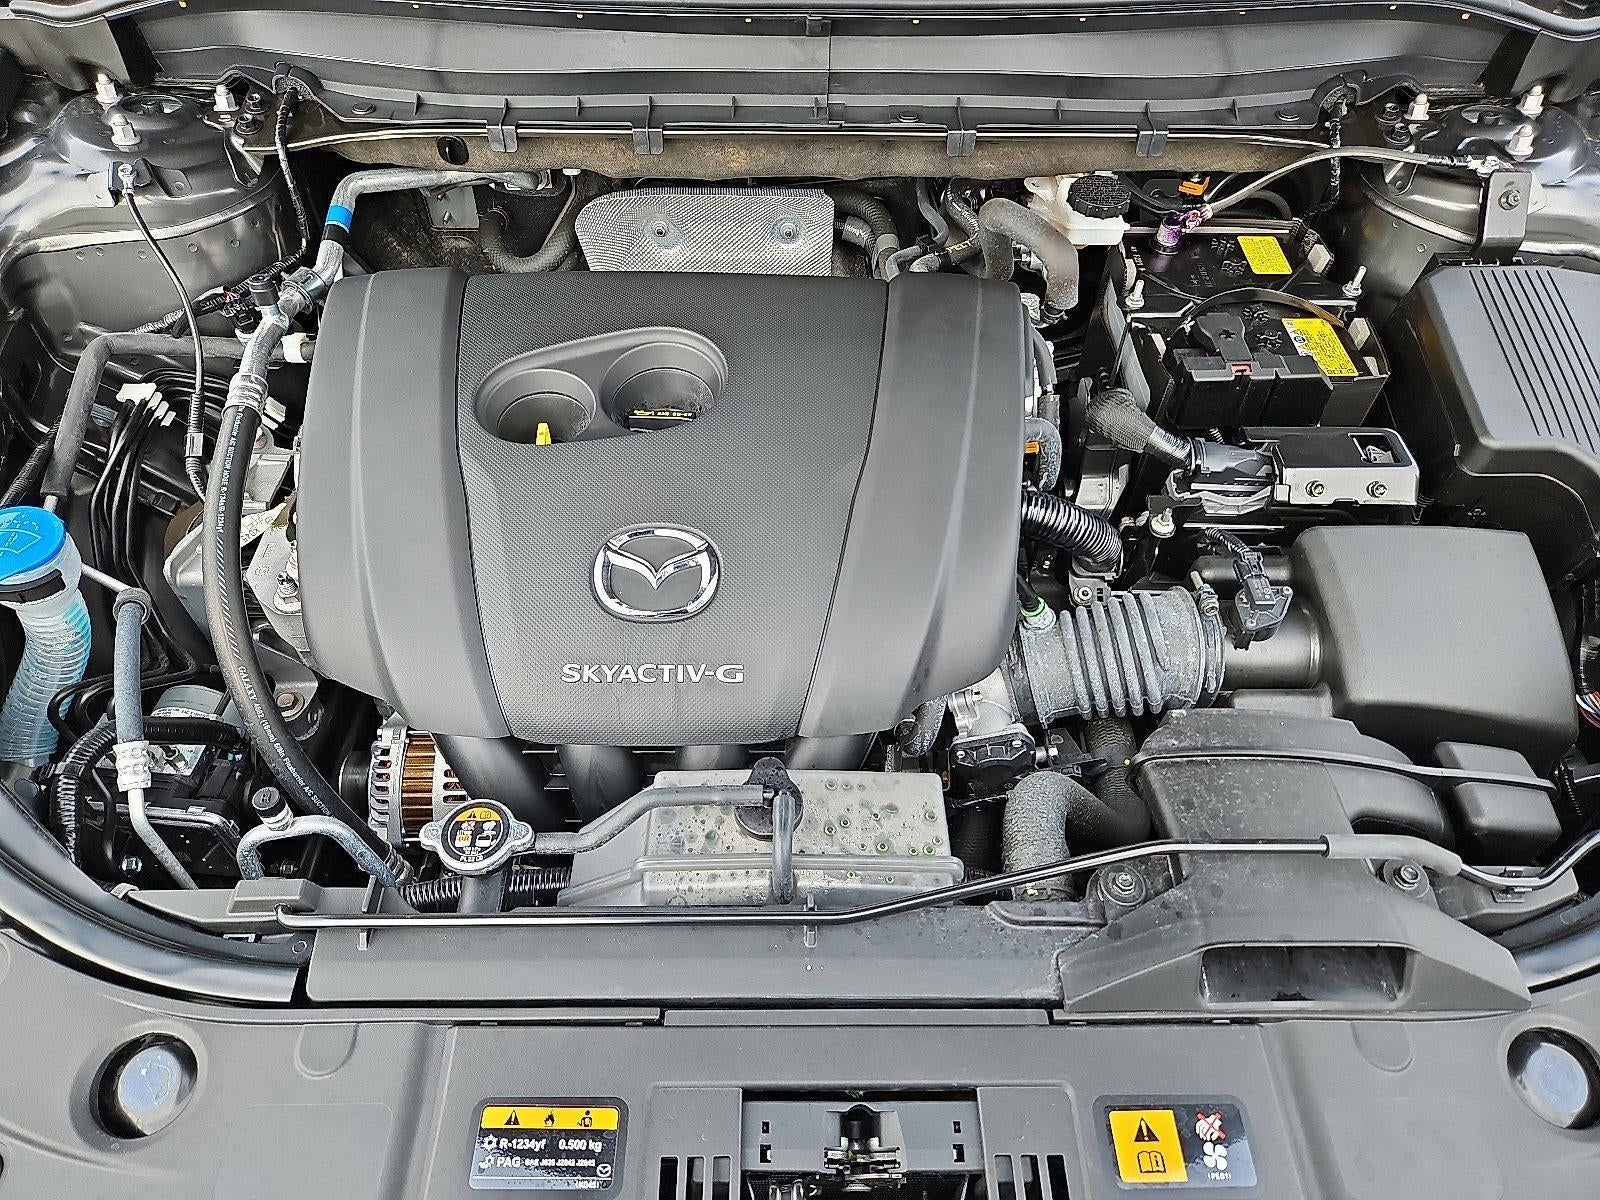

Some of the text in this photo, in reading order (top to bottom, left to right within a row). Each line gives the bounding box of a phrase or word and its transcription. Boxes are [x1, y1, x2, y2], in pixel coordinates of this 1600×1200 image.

[224, 446, 235, 470] SUCTION
[221, 470, 230, 486] HOSE
[561, 663, 745, 683] SKYACTIV-G
[238, 665, 257, 701] GALAXY
[303, 785, 315, 797] A/C
[310, 795, 332, 815] SUCTION
[499, 1138, 602, 1152] R-1234yf 0.500 kg
[497, 1156, 520, 1168] PAG
